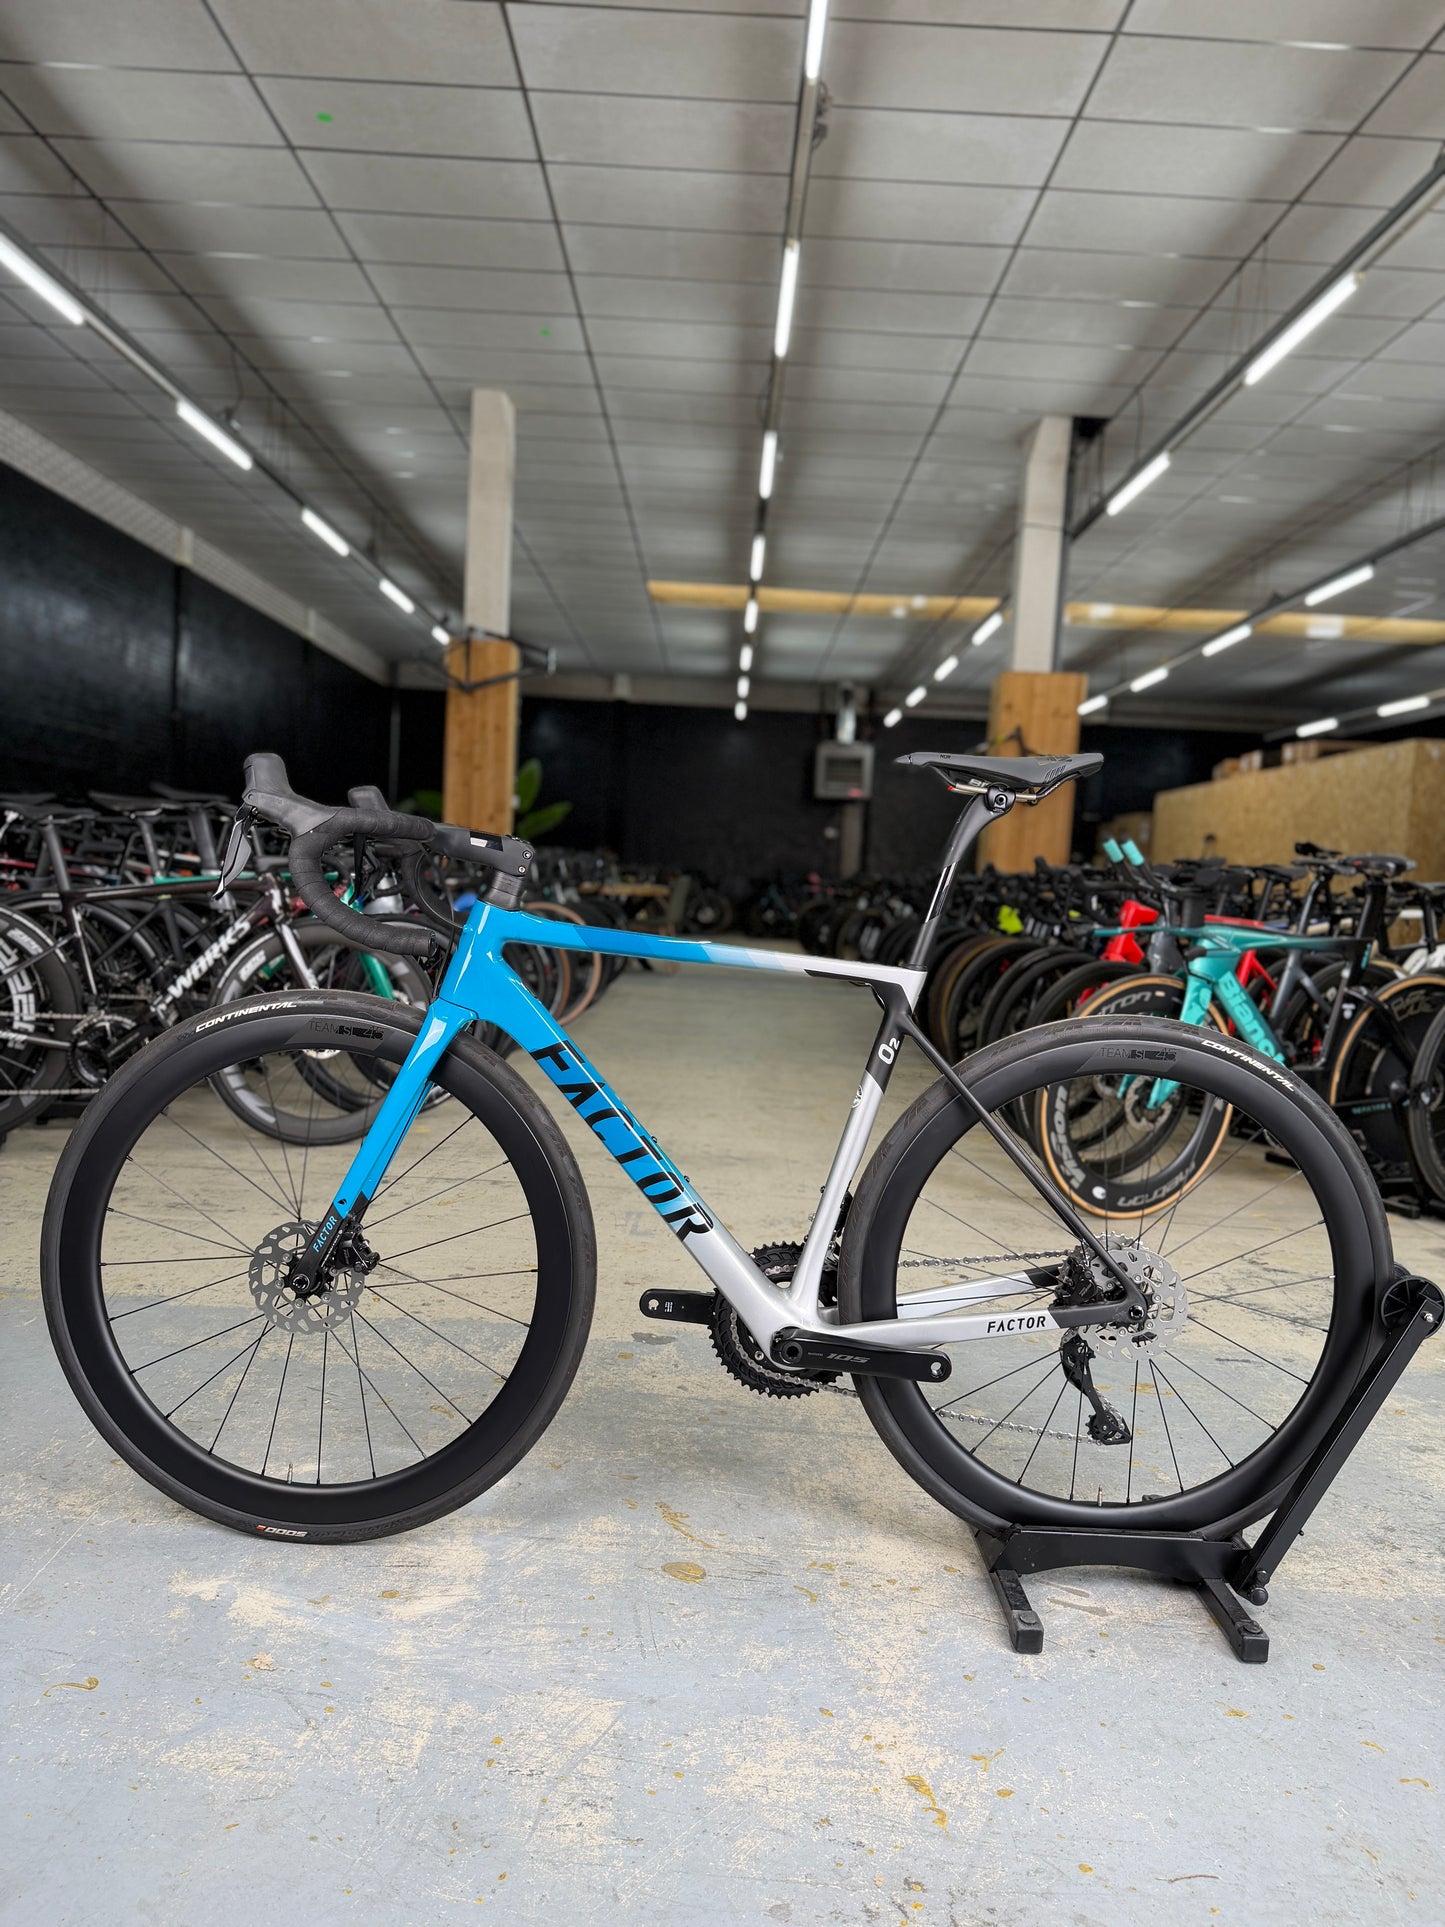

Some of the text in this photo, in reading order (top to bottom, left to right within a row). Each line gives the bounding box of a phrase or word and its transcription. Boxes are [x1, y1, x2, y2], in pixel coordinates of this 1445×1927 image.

[195, 1001, 298, 1033] CONTINENTAL
[308, 1020, 339, 1034] TEAM
[1217, 970, 1286, 1067] Bianc
[1101, 1047, 1130, 1058] TEAM
[1201, 1039, 1295, 1092] CONTINENTAL
[530, 1039, 714, 1242] FACTOR
[312, 1215, 338, 1253] FACTOR
[987, 1316, 1047, 1333] FACTOR
[827, 1352, 871, 1364] 105
